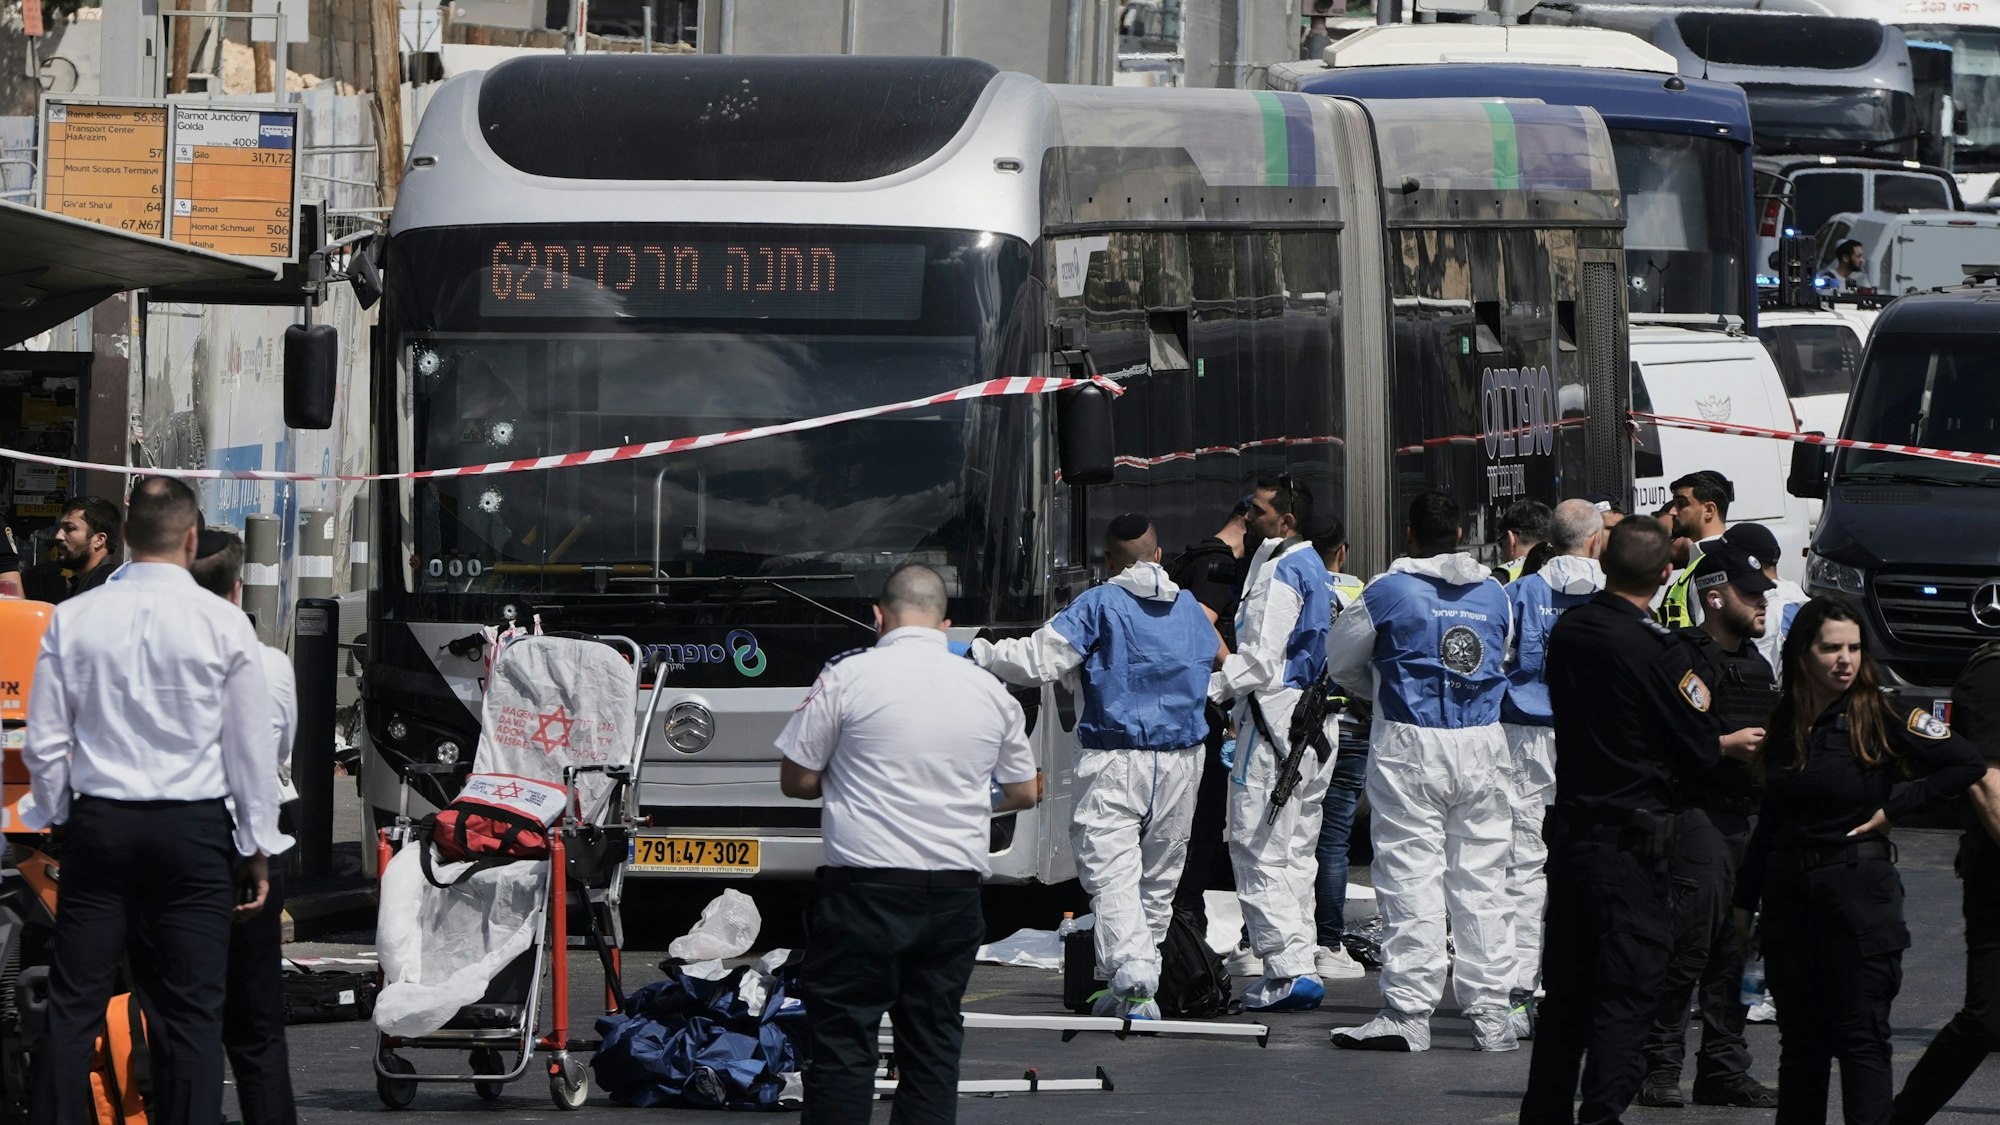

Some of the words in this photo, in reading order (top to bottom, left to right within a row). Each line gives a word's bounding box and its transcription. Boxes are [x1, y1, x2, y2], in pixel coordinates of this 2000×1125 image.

[67, 110, 94, 118] Ramat
[133, 111, 165, 123] 56,86
[177, 111, 208, 121] Ramot
[210, 112, 252, 122] Junction/
[67, 124, 106, 133] Transport
[108, 125, 135, 134] Center
[177, 121, 204, 131] Golda
[66, 133, 107, 141] HaArazim
[232, 138, 258, 147] 4009
[149, 148, 164, 158] 57
[194, 151, 209, 159] Gilo
[251, 152, 292, 165] 31,71,72
[65, 164, 90, 172] Mount
[92, 165, 121, 175] Scopus
[123, 166, 159, 175] Terminal
[151, 184, 163, 194] 61
[63, 200, 87, 208] Giv'at
[88, 201, 113, 209] Sha'ul
[192, 205, 218, 213] Ramot
[275, 207, 290, 217] 62
[191, 223, 217, 231] Homat
[220, 223, 255, 232] Schmuel
[266, 225, 289, 235] 506
[270, 242, 289, 253] 516
[492, 241, 538, 300] 62
[543, 245, 699, 290] מרכזית
[726, 246, 836, 292] תחנה
[1482, 365, 1554, 460] סופרבוס
[1431, 608, 1458, 618] ישראל
[1459, 610, 1488, 621] משטרת
[502, 705, 535, 720] MAGEN
[499, 714, 526, 728] DAVID
[496, 725, 525, 737] ADOM
